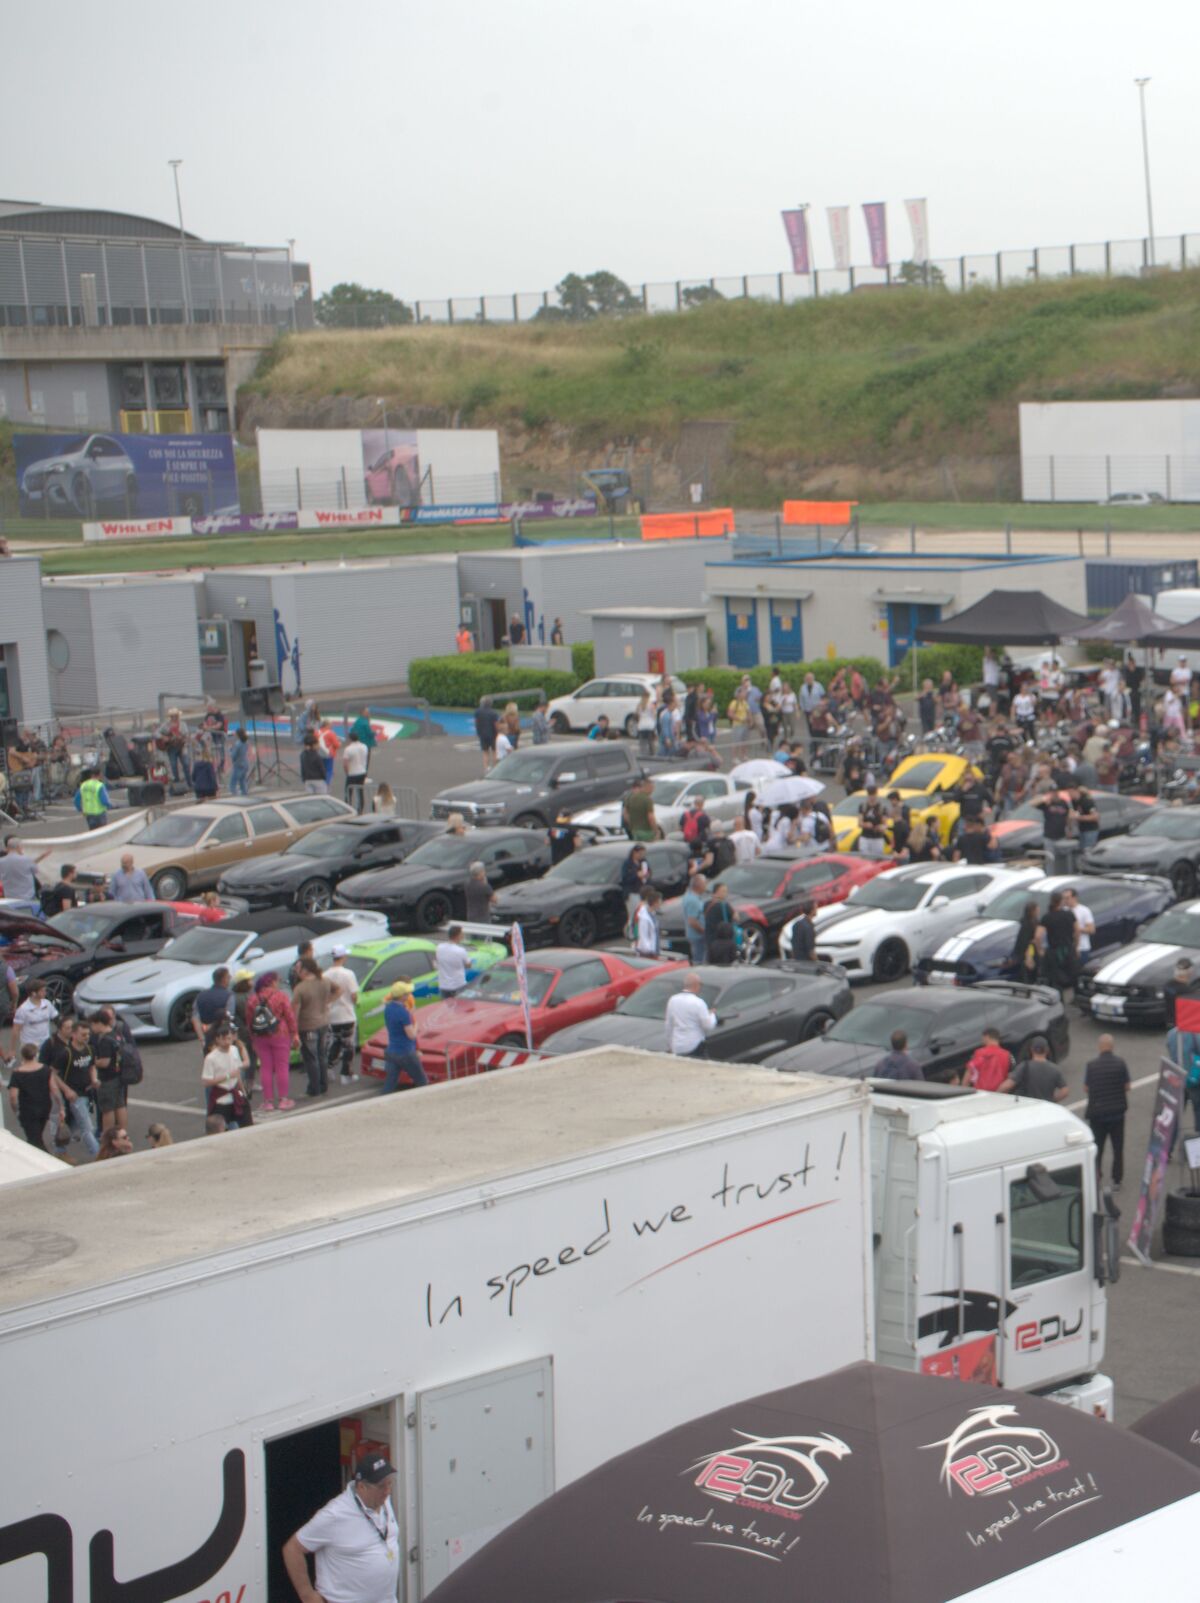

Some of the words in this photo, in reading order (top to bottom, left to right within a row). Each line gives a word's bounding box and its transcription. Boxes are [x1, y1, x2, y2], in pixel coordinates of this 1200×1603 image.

[101, 519, 173, 535] WHELEN
[315, 508, 383, 523] WHELEN
[426, 1282, 463, 1328] In
[485, 1199, 612, 1317] speed
[632, 1193, 693, 1237] we
[658, 1507, 714, 1532] speed
[712, 1520, 735, 1535] we
[985, 1499, 1022, 1543] speed
[1024, 1499, 1047, 1514] we
